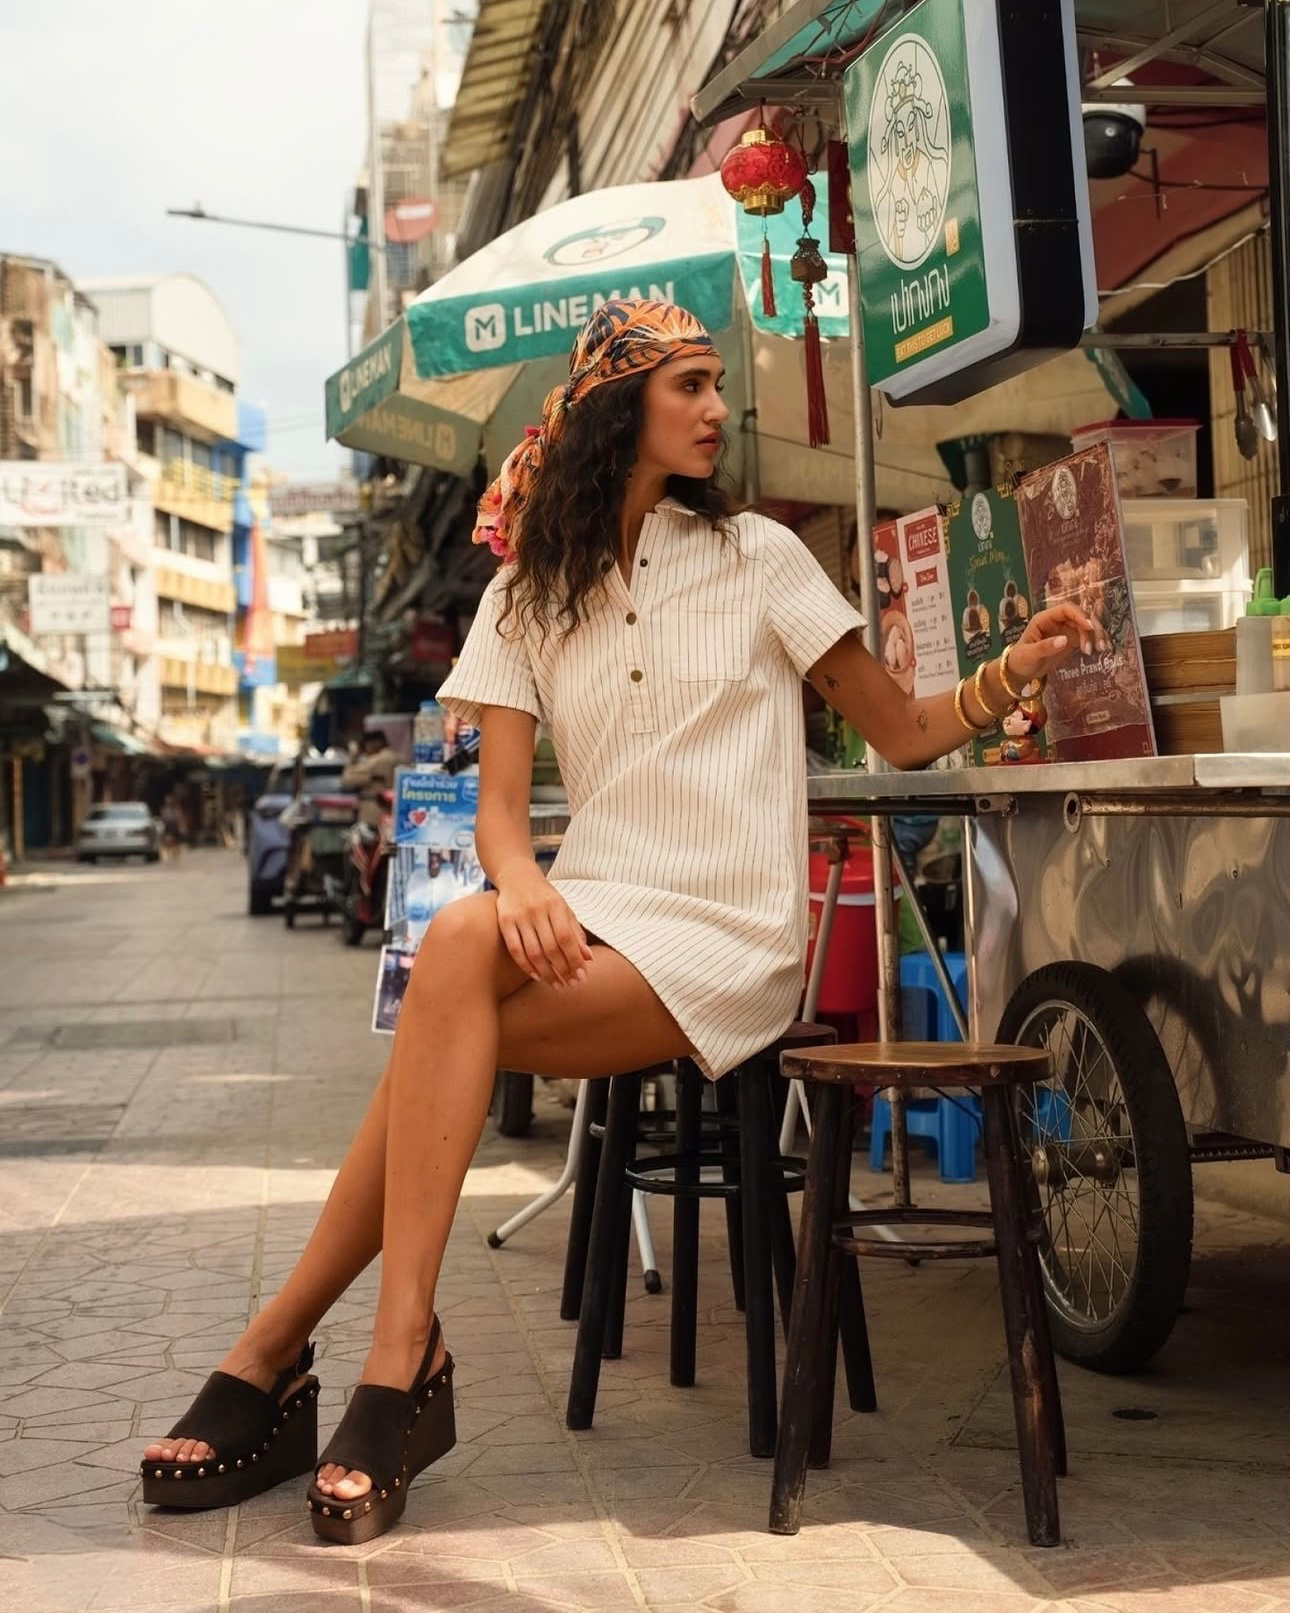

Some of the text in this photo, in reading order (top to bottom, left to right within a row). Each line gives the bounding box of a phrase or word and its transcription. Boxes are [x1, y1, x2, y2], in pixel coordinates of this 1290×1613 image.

[908, 526, 937, 551] CHINESE
[1059, 667, 1080, 680] Three
[1103, 656, 1123, 670] Balls
[402, 789, 457, 803] โครงการ
